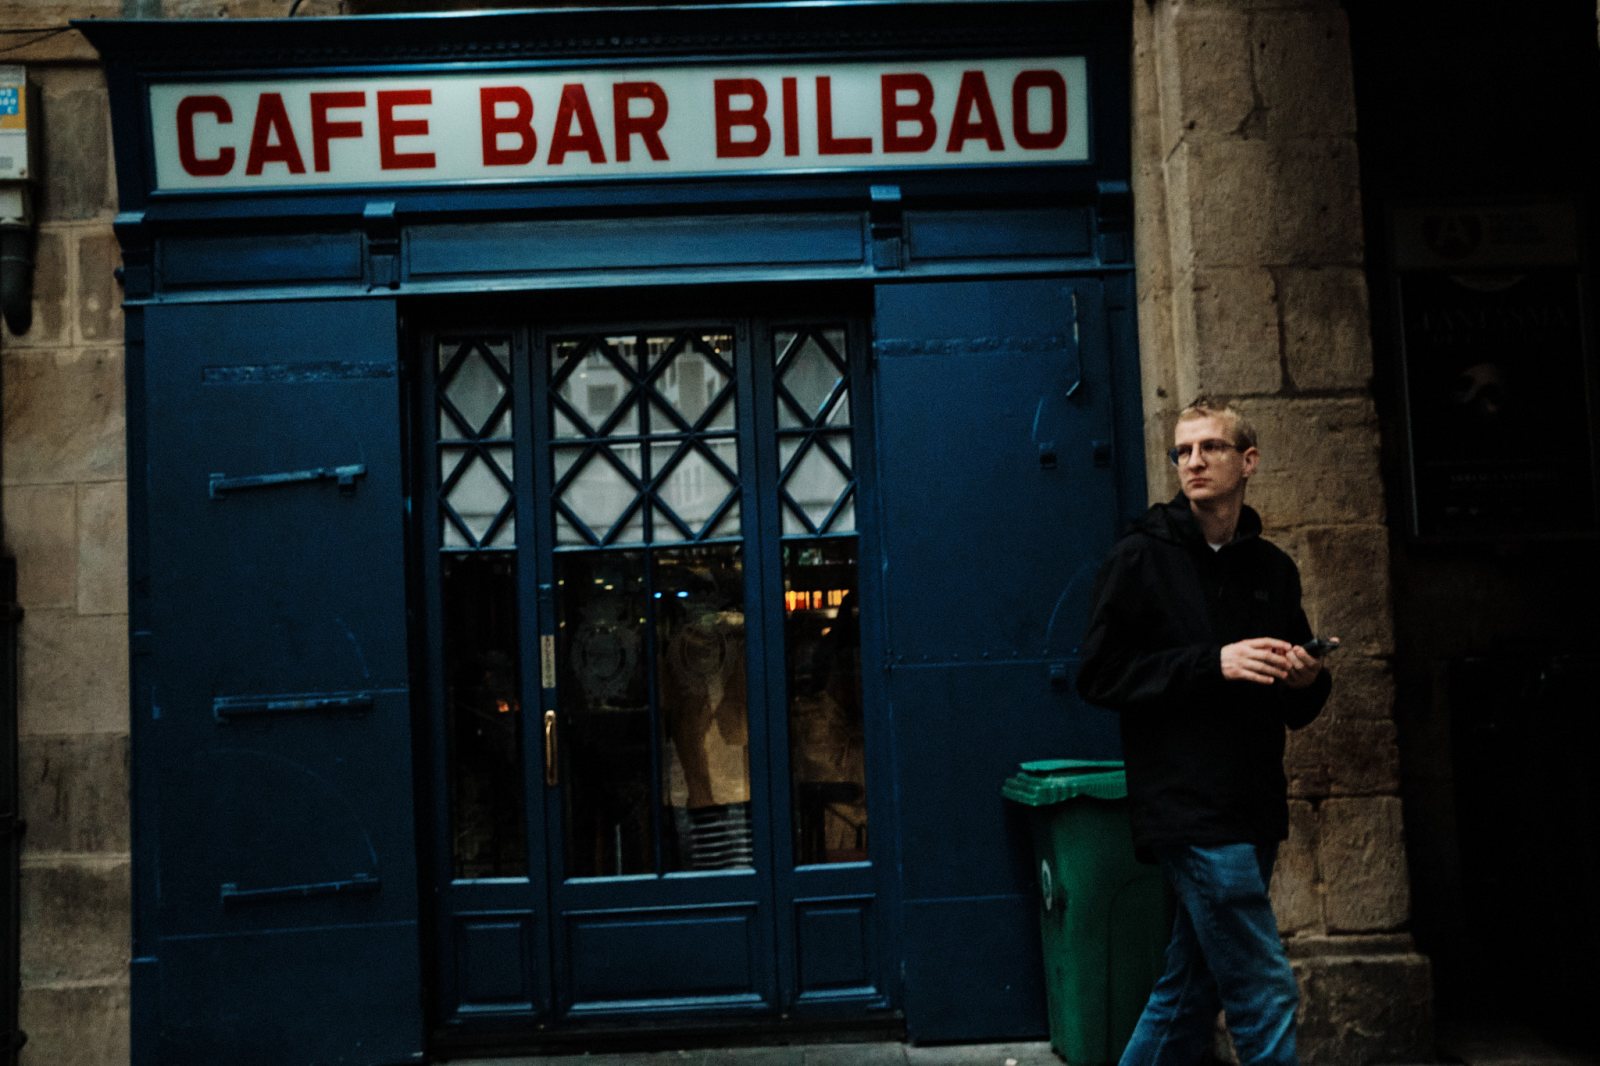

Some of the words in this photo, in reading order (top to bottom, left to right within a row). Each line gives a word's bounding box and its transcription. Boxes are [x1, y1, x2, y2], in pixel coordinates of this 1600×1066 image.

[176, 90, 436, 177] CAFE
[479, 81, 671, 167] BAR
[713, 69, 1068, 159] BILBAO
